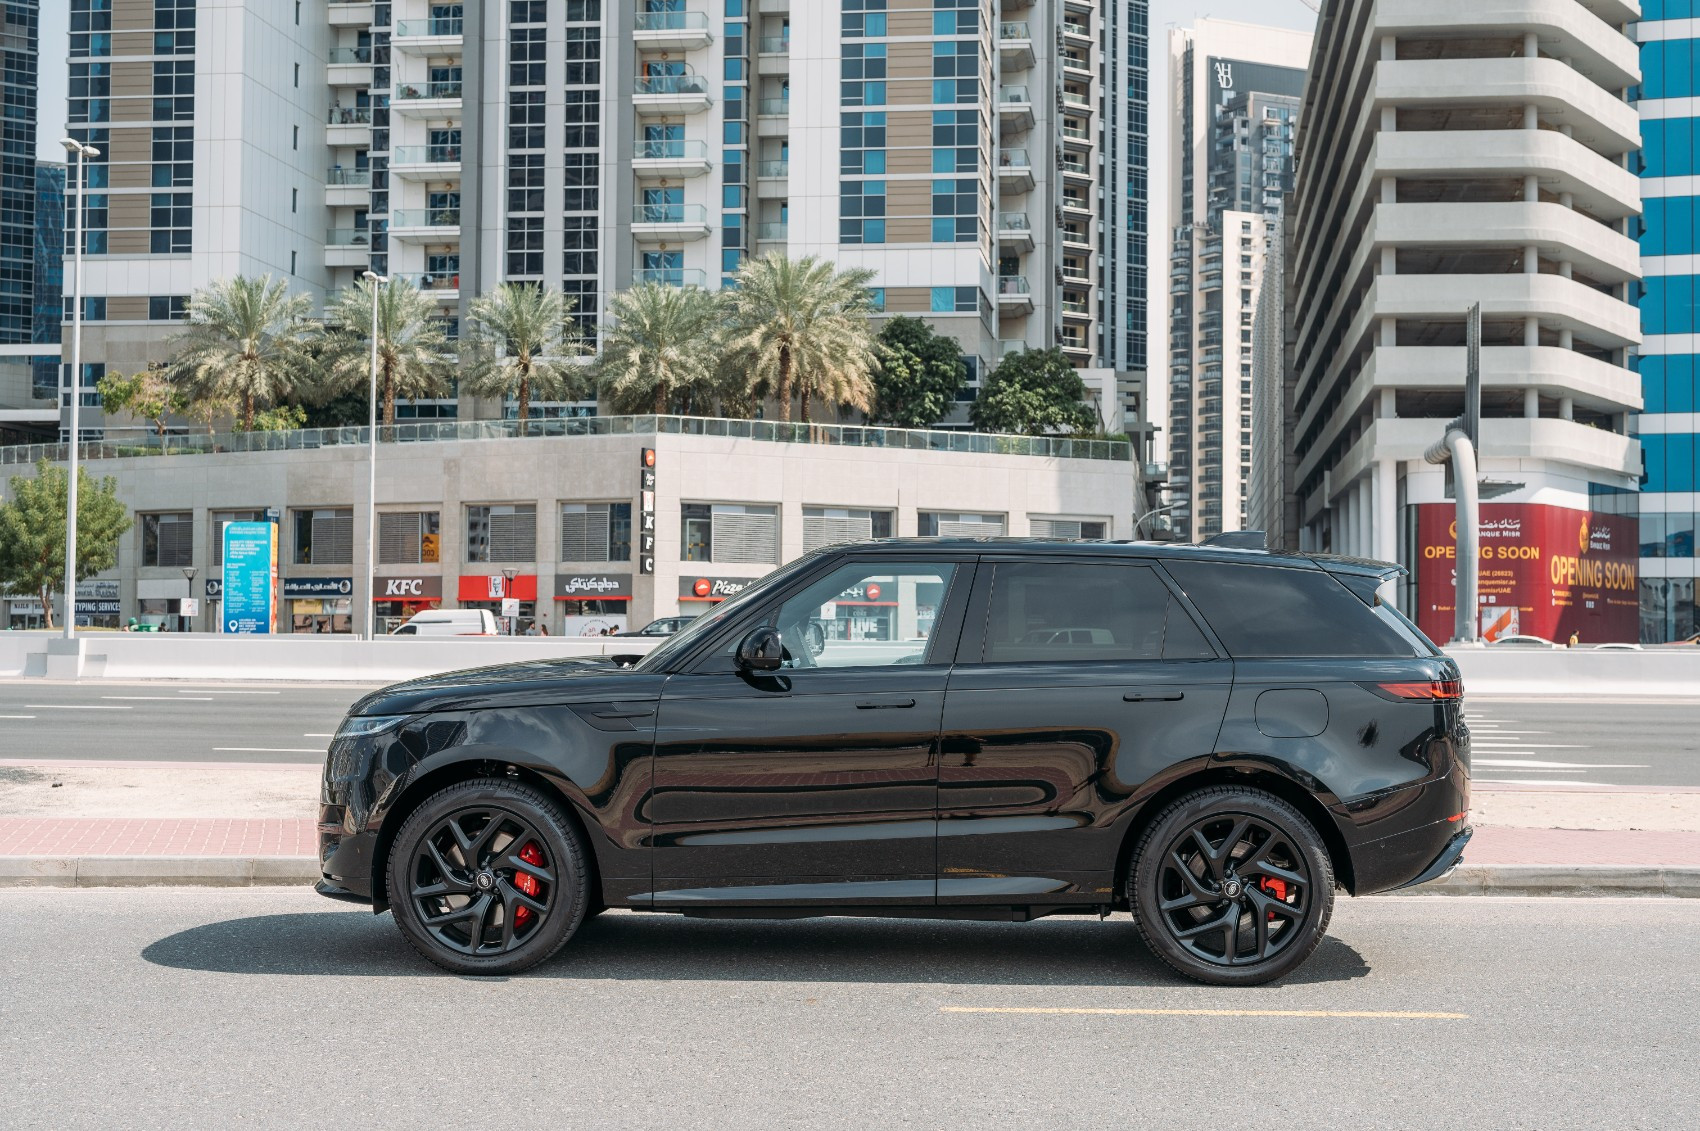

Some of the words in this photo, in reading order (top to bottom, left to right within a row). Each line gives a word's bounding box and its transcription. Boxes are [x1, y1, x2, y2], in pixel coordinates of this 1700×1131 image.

[645, 515, 655, 572] KFC
[1424, 546, 1493, 559] OPEG
[1497, 546, 1540, 559] SOON
[1551, 555, 1603, 588] OPENING
[1605, 561, 1635, 591] SOON
[386, 579, 423, 595] KFC
[565, 577, 598, 593] كنتاكي
[598, 577, 619, 592] دجاج
[75, 602, 96, 611] TYPING
[98, 602, 121, 611] SERVICES
[851, 618, 878, 632] LIVE
